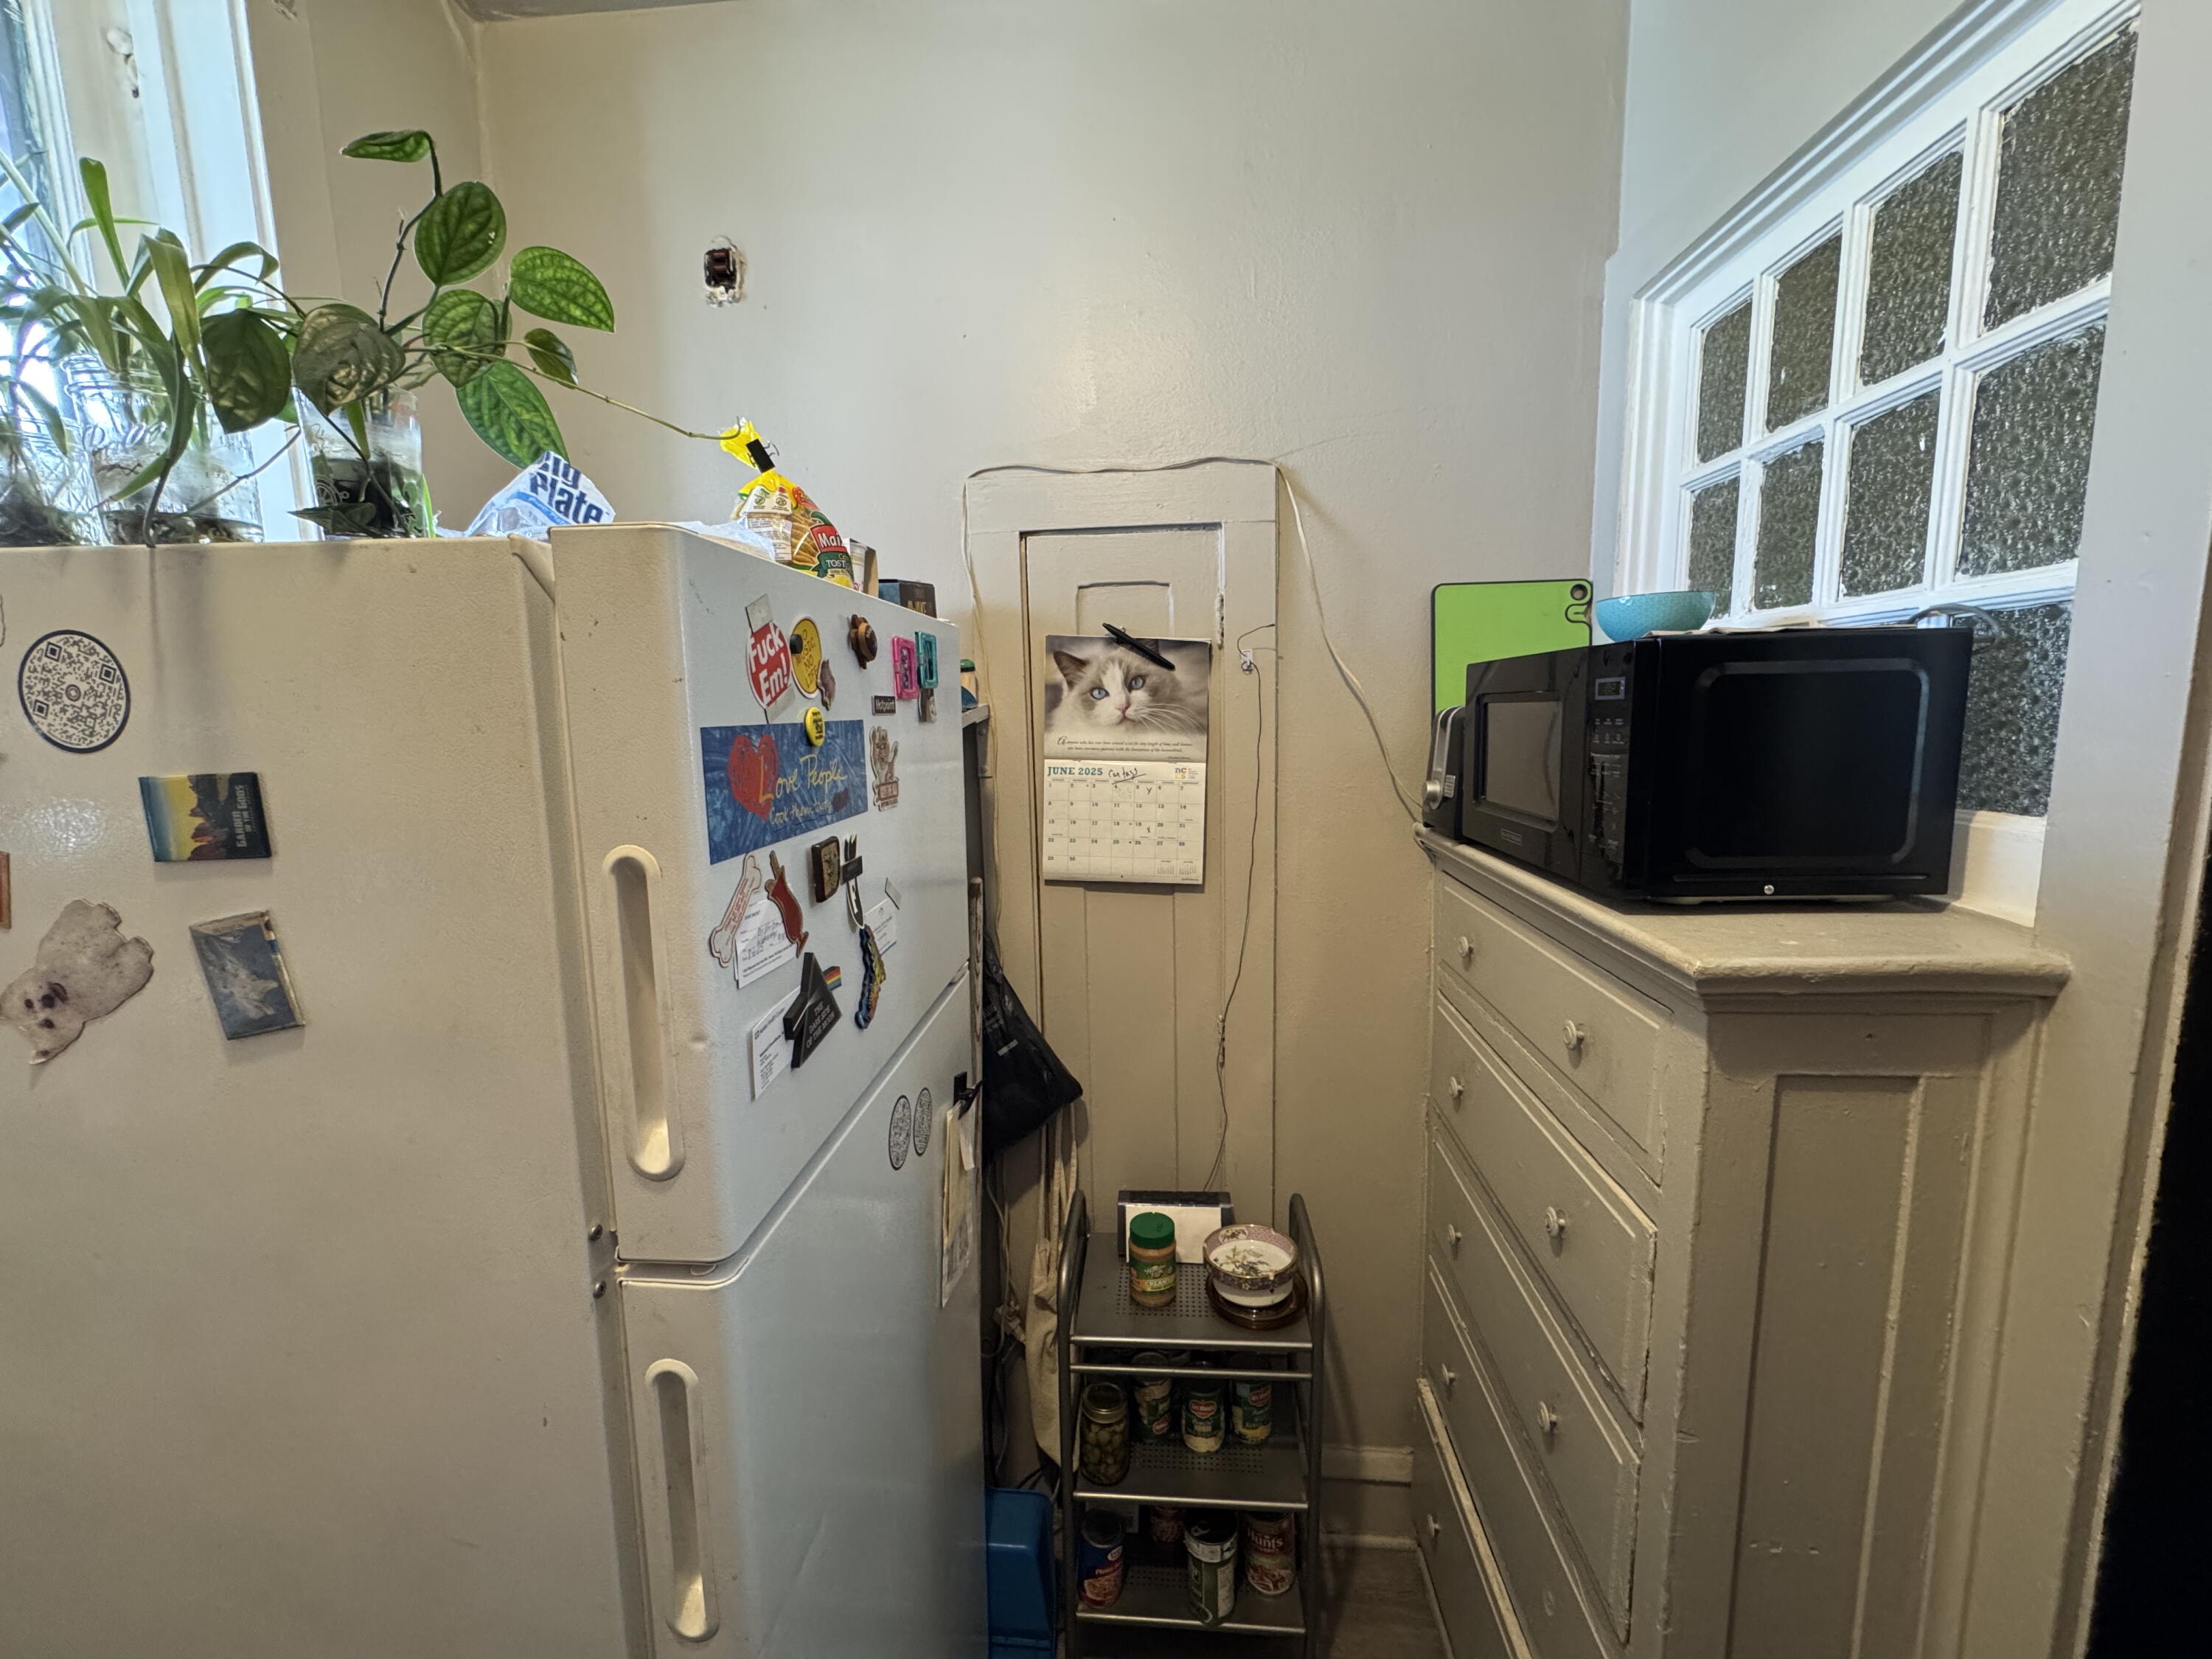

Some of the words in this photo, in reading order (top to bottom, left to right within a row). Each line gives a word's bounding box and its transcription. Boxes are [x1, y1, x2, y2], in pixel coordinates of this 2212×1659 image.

[529, 471, 604, 524] Plate
[748, 622, 785, 673] Fuck
[804, 655, 814, 672] NO
[758, 653, 788, 705] Em!
[759, 754, 801, 804] Love
[799, 754, 848, 795] People
[1047, 766, 1075, 776] JUNE
[1078, 767, 1103, 776] 2025
[234, 785, 248, 809] GODS
[232, 810, 248, 848] GARDEN
[808, 1015, 822, 1034] DARK
[821, 1004, 831, 1021] SIDE
[814, 1000, 824, 1017] THE
[806, 1035, 813, 1049] OF
[813, 1025, 822, 1041] THE
[821, 1009, 835, 1030] MOON
